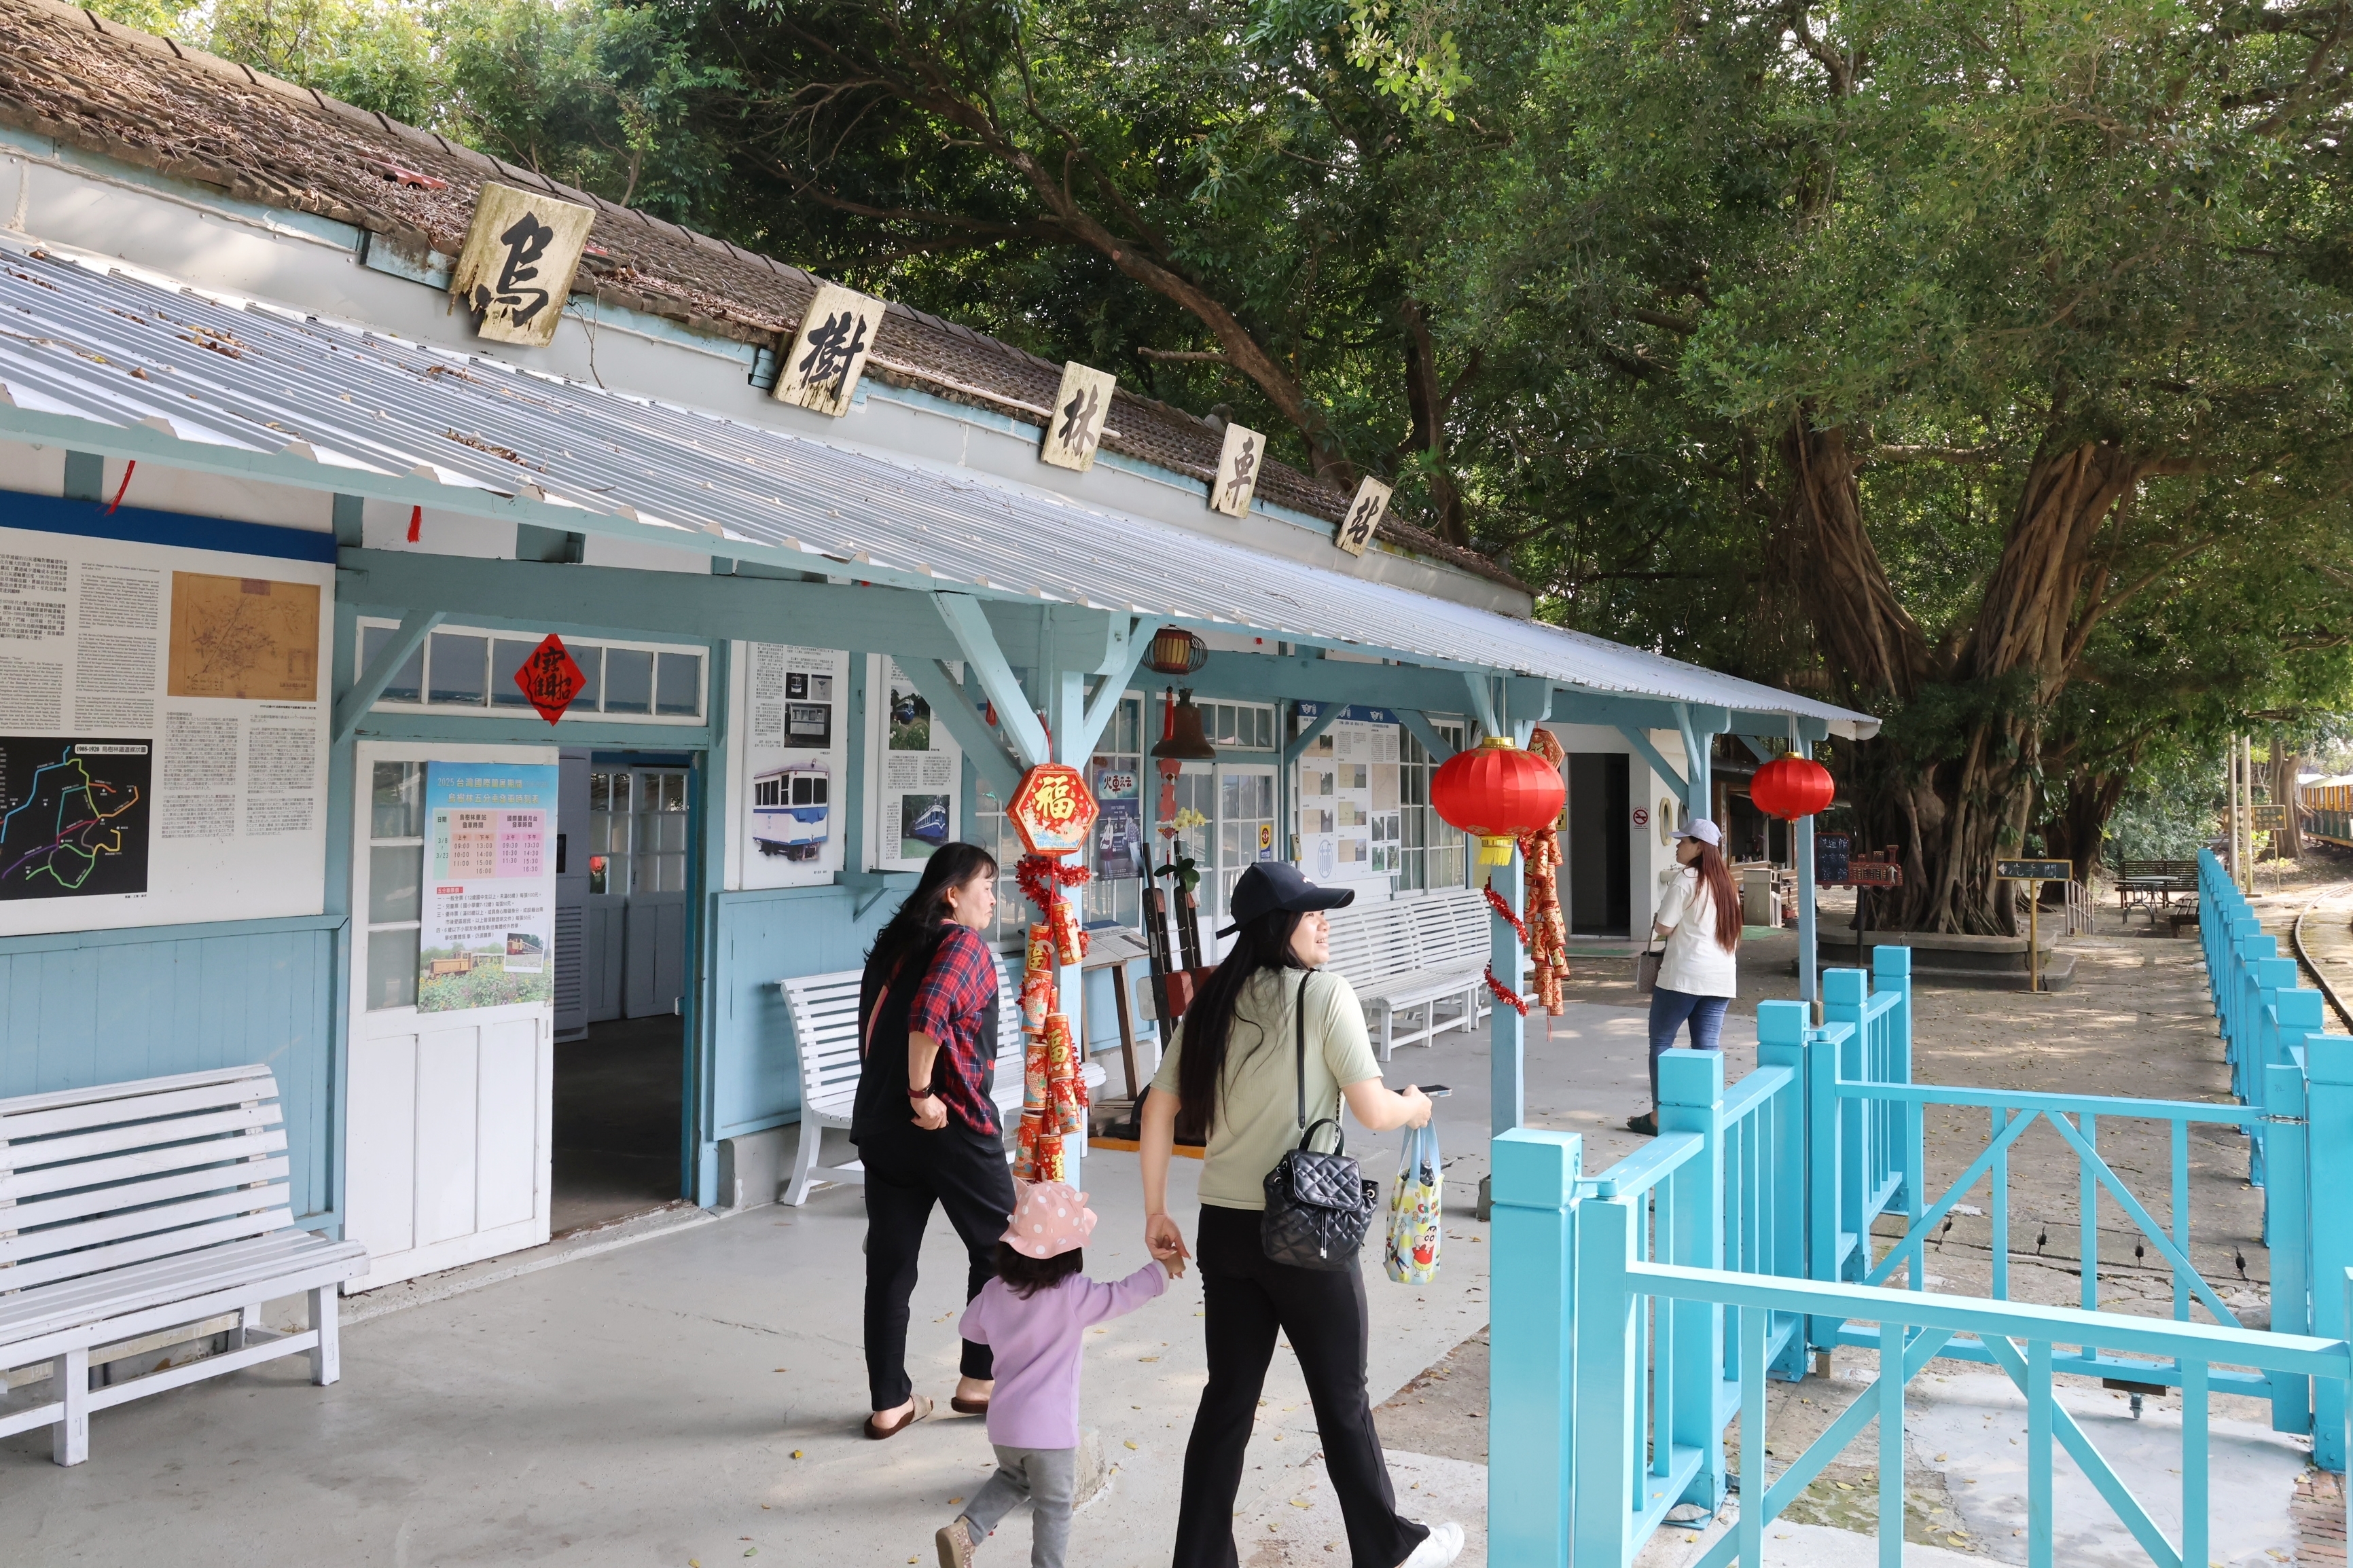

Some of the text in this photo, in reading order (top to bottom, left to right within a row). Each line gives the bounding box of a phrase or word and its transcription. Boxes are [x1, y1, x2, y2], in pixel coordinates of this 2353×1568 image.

[476, 211, 1380, 545] 烏 樹 林 車 站
[437, 778, 454, 786] 2025
[456, 778, 522, 788] 台灣國際蘭展期間
[448, 793, 539, 804] 烏樹林五分車發車時刻表
[1035, 775, 1076, 820] 福
